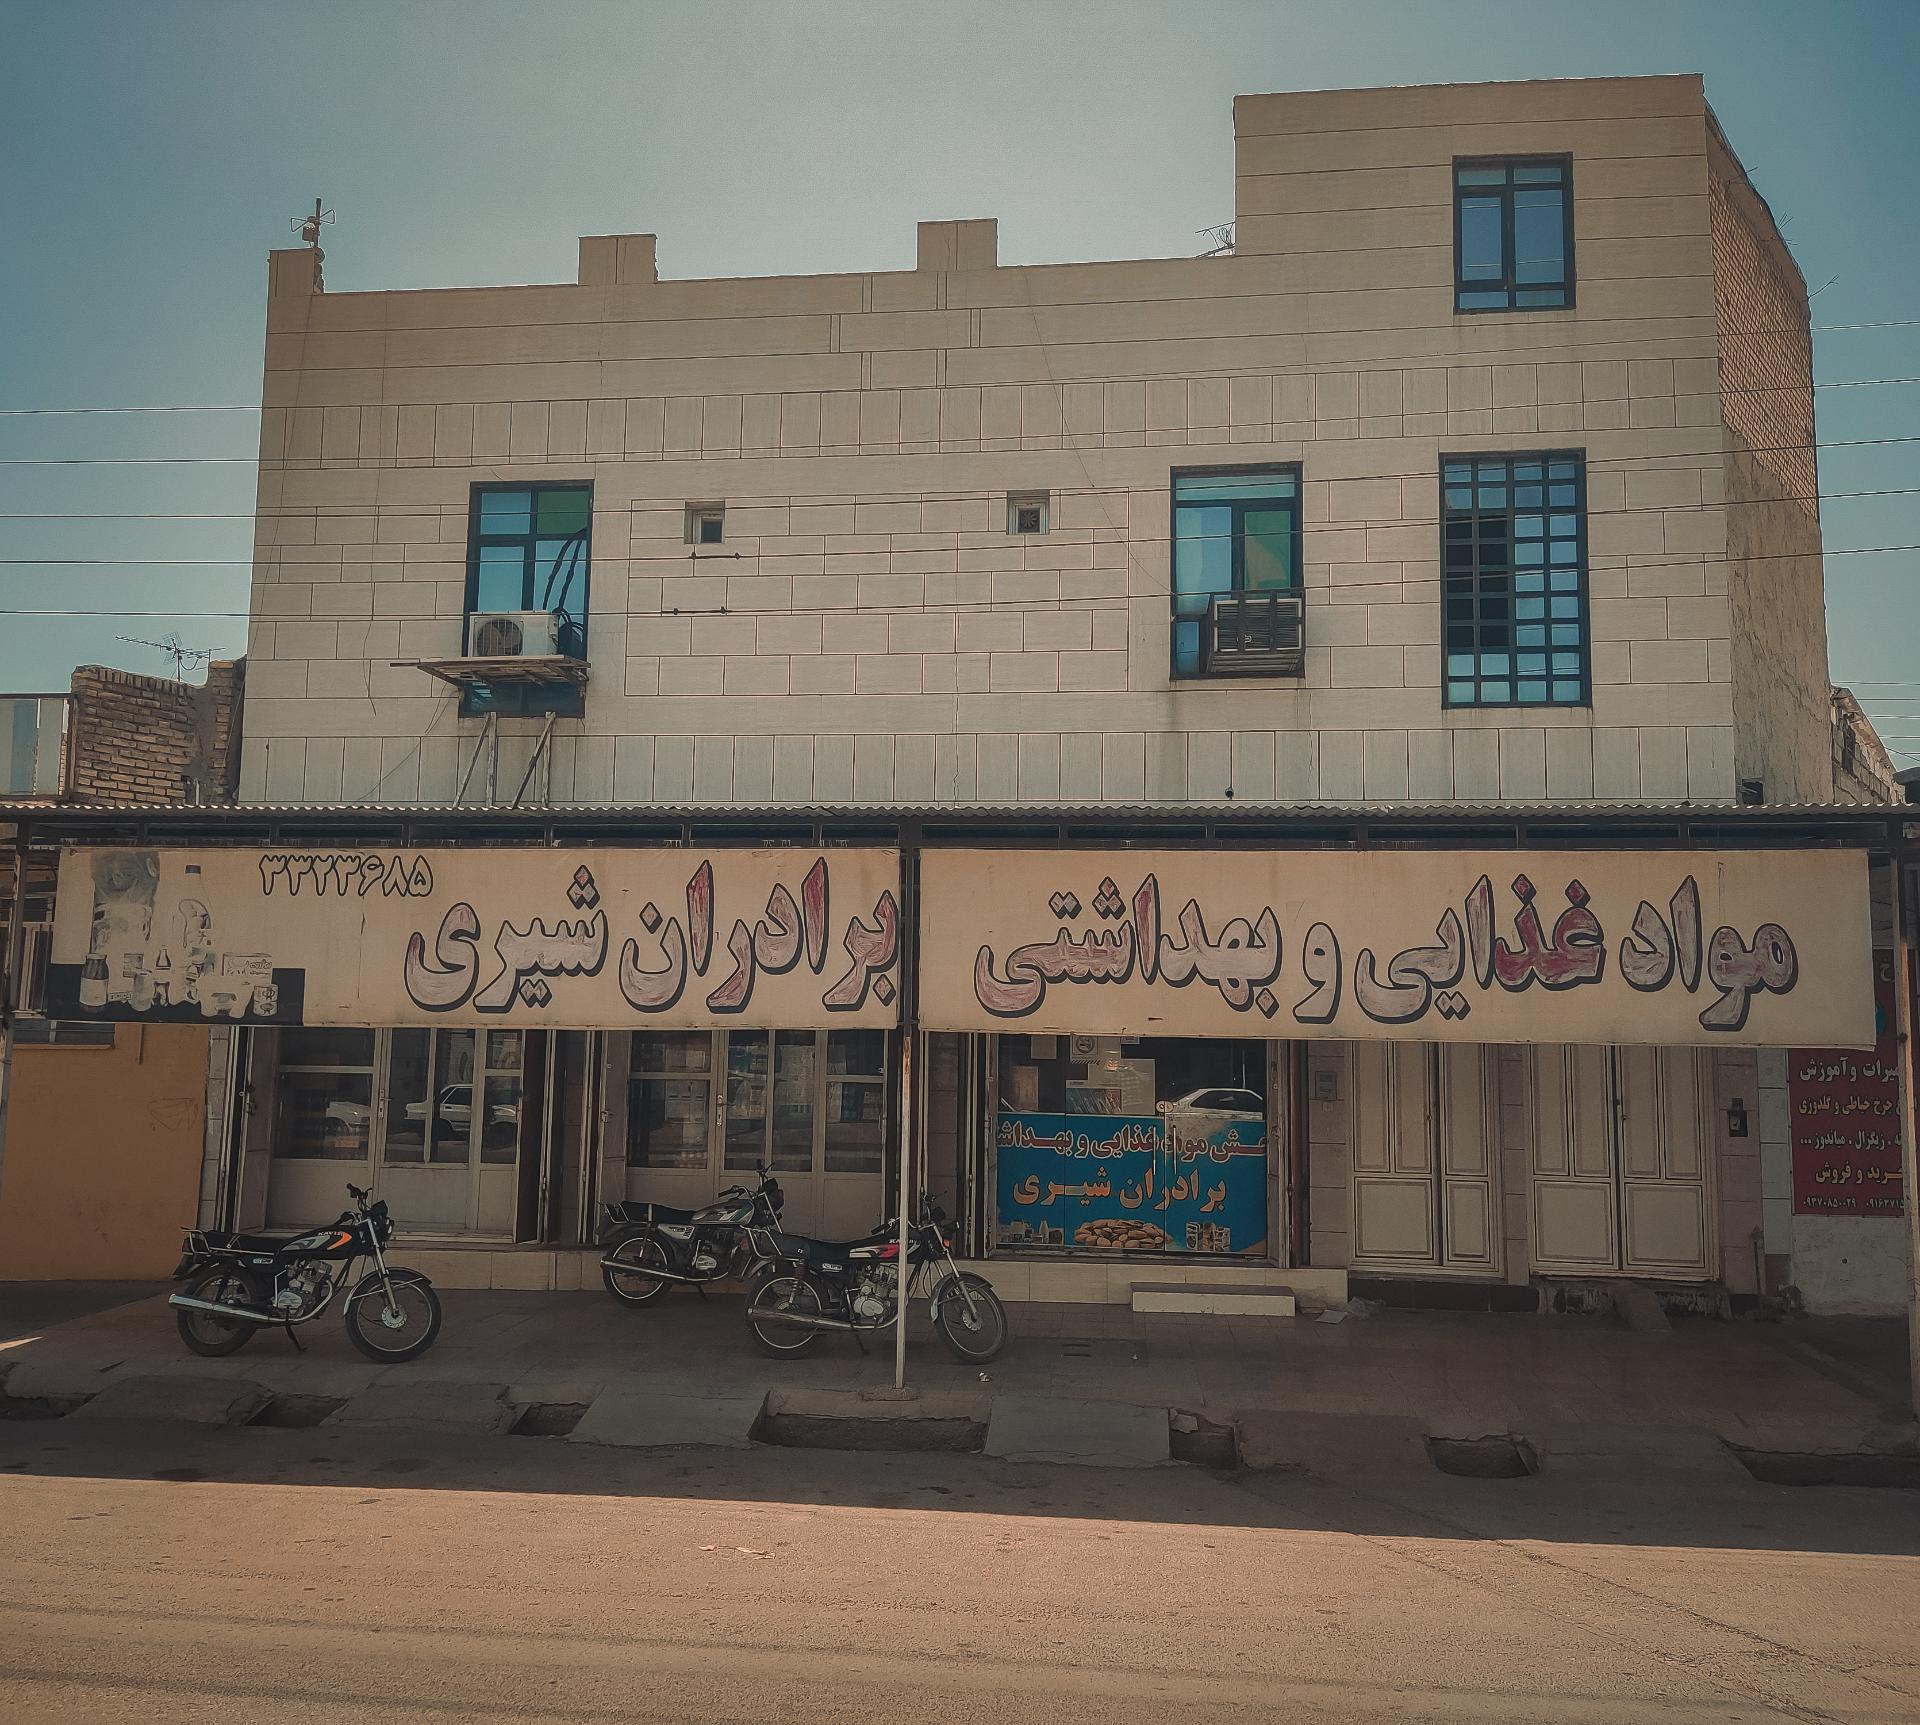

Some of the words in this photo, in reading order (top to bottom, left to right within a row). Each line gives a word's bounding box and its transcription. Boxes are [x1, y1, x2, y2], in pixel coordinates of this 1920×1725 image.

[259, 854, 434, 897] ۳۳۲۳۶۸۵
[403, 864, 609, 1014] شیری
[618, 856, 901, 1013] برادران
[974, 872, 1282, 1020] بهداشتی
[1353, 873, 1607, 1025] غذایی
[1619, 874, 1799, 1032] مواد
[1292, 921, 1343, 1025] و
[1799, 1056, 1849, 1082] آموزش
[1850, 1068, 1858, 1082] و
[1833, 1101, 1840, 1115] و
[996, 1120, 1074, 1157] بهداش
[1074, 1133, 1090, 1158] و
[1013, 1166, 1112, 1207] شیری
[1119, 1168, 1228, 1214] برادران
[1815, 1160, 1852, 1184] فروش
[1856, 1168, 1863, 1184] و
